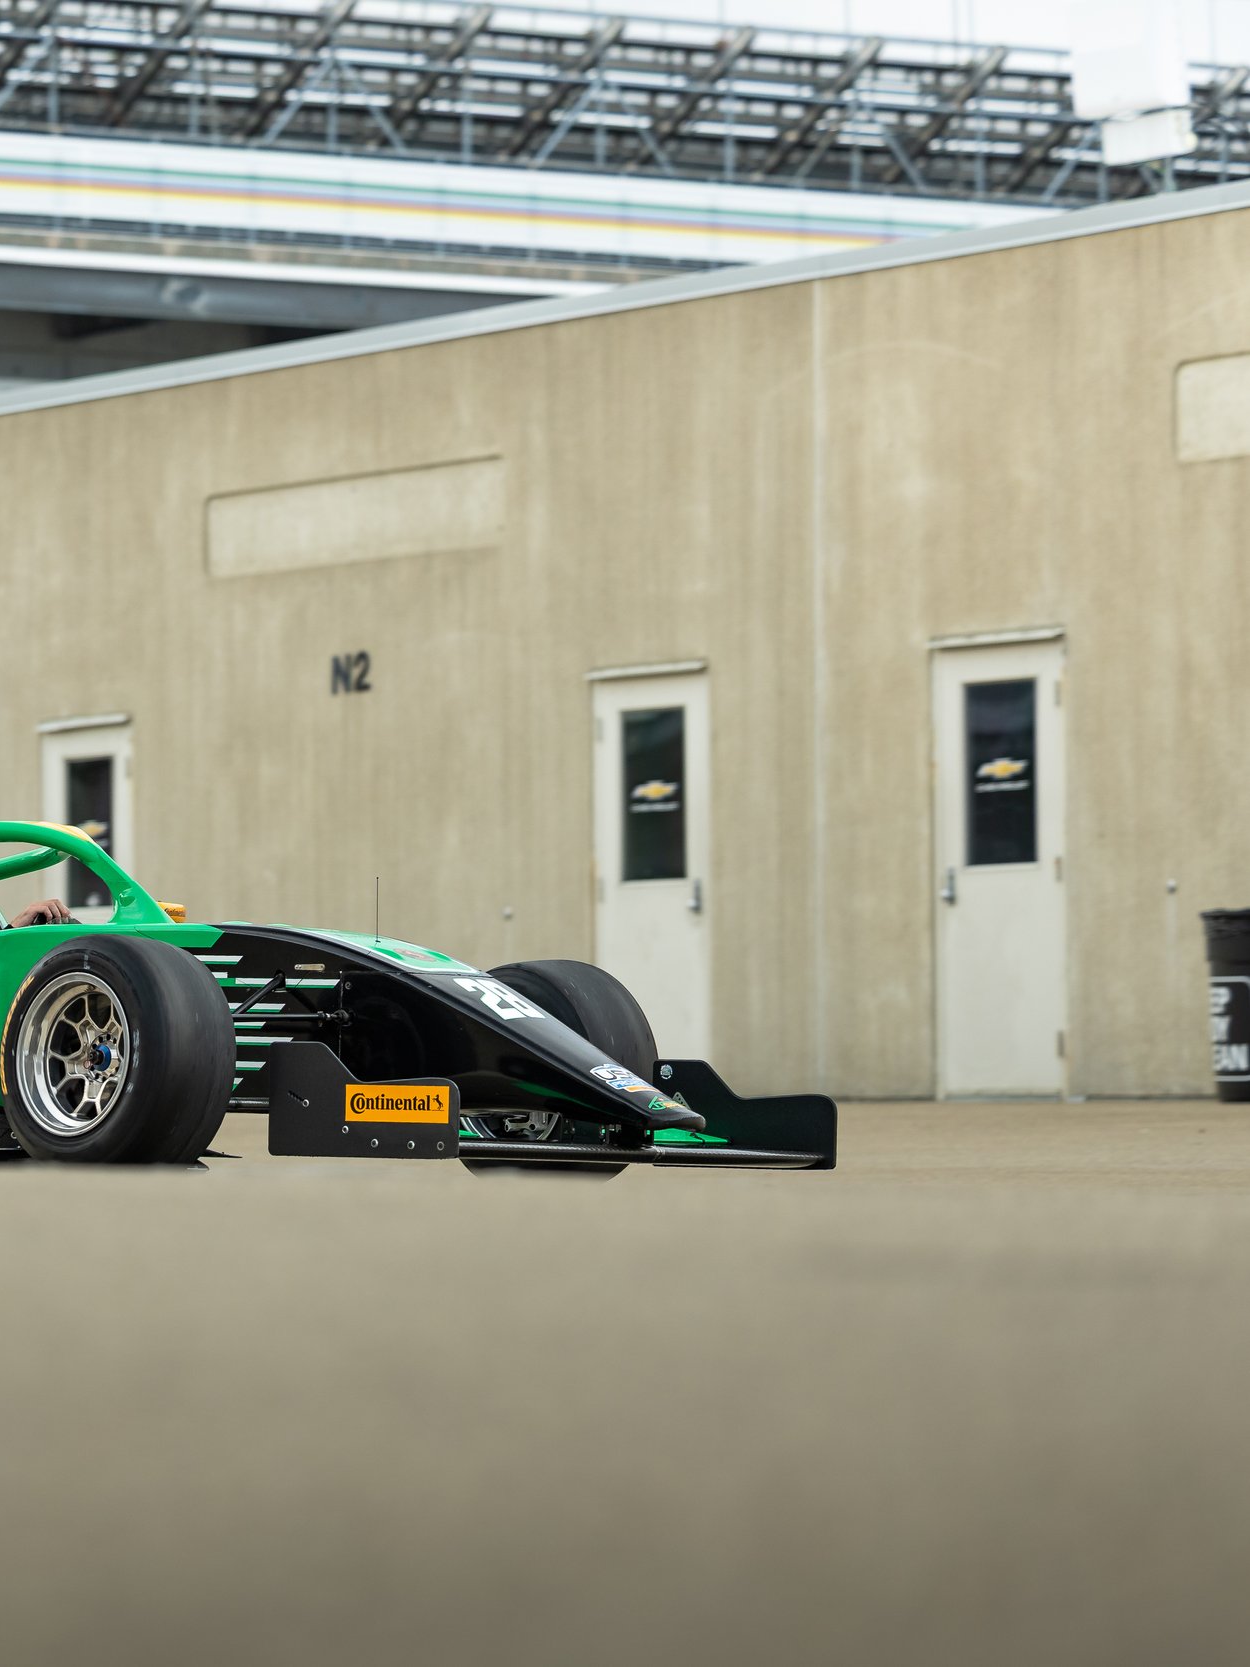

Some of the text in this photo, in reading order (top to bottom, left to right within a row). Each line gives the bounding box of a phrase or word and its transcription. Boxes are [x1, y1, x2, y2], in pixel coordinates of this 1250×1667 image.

[331, 650, 372, 695] N2
[453, 977, 546, 1020] 28
[350, 1092, 431, 1114] Continental
